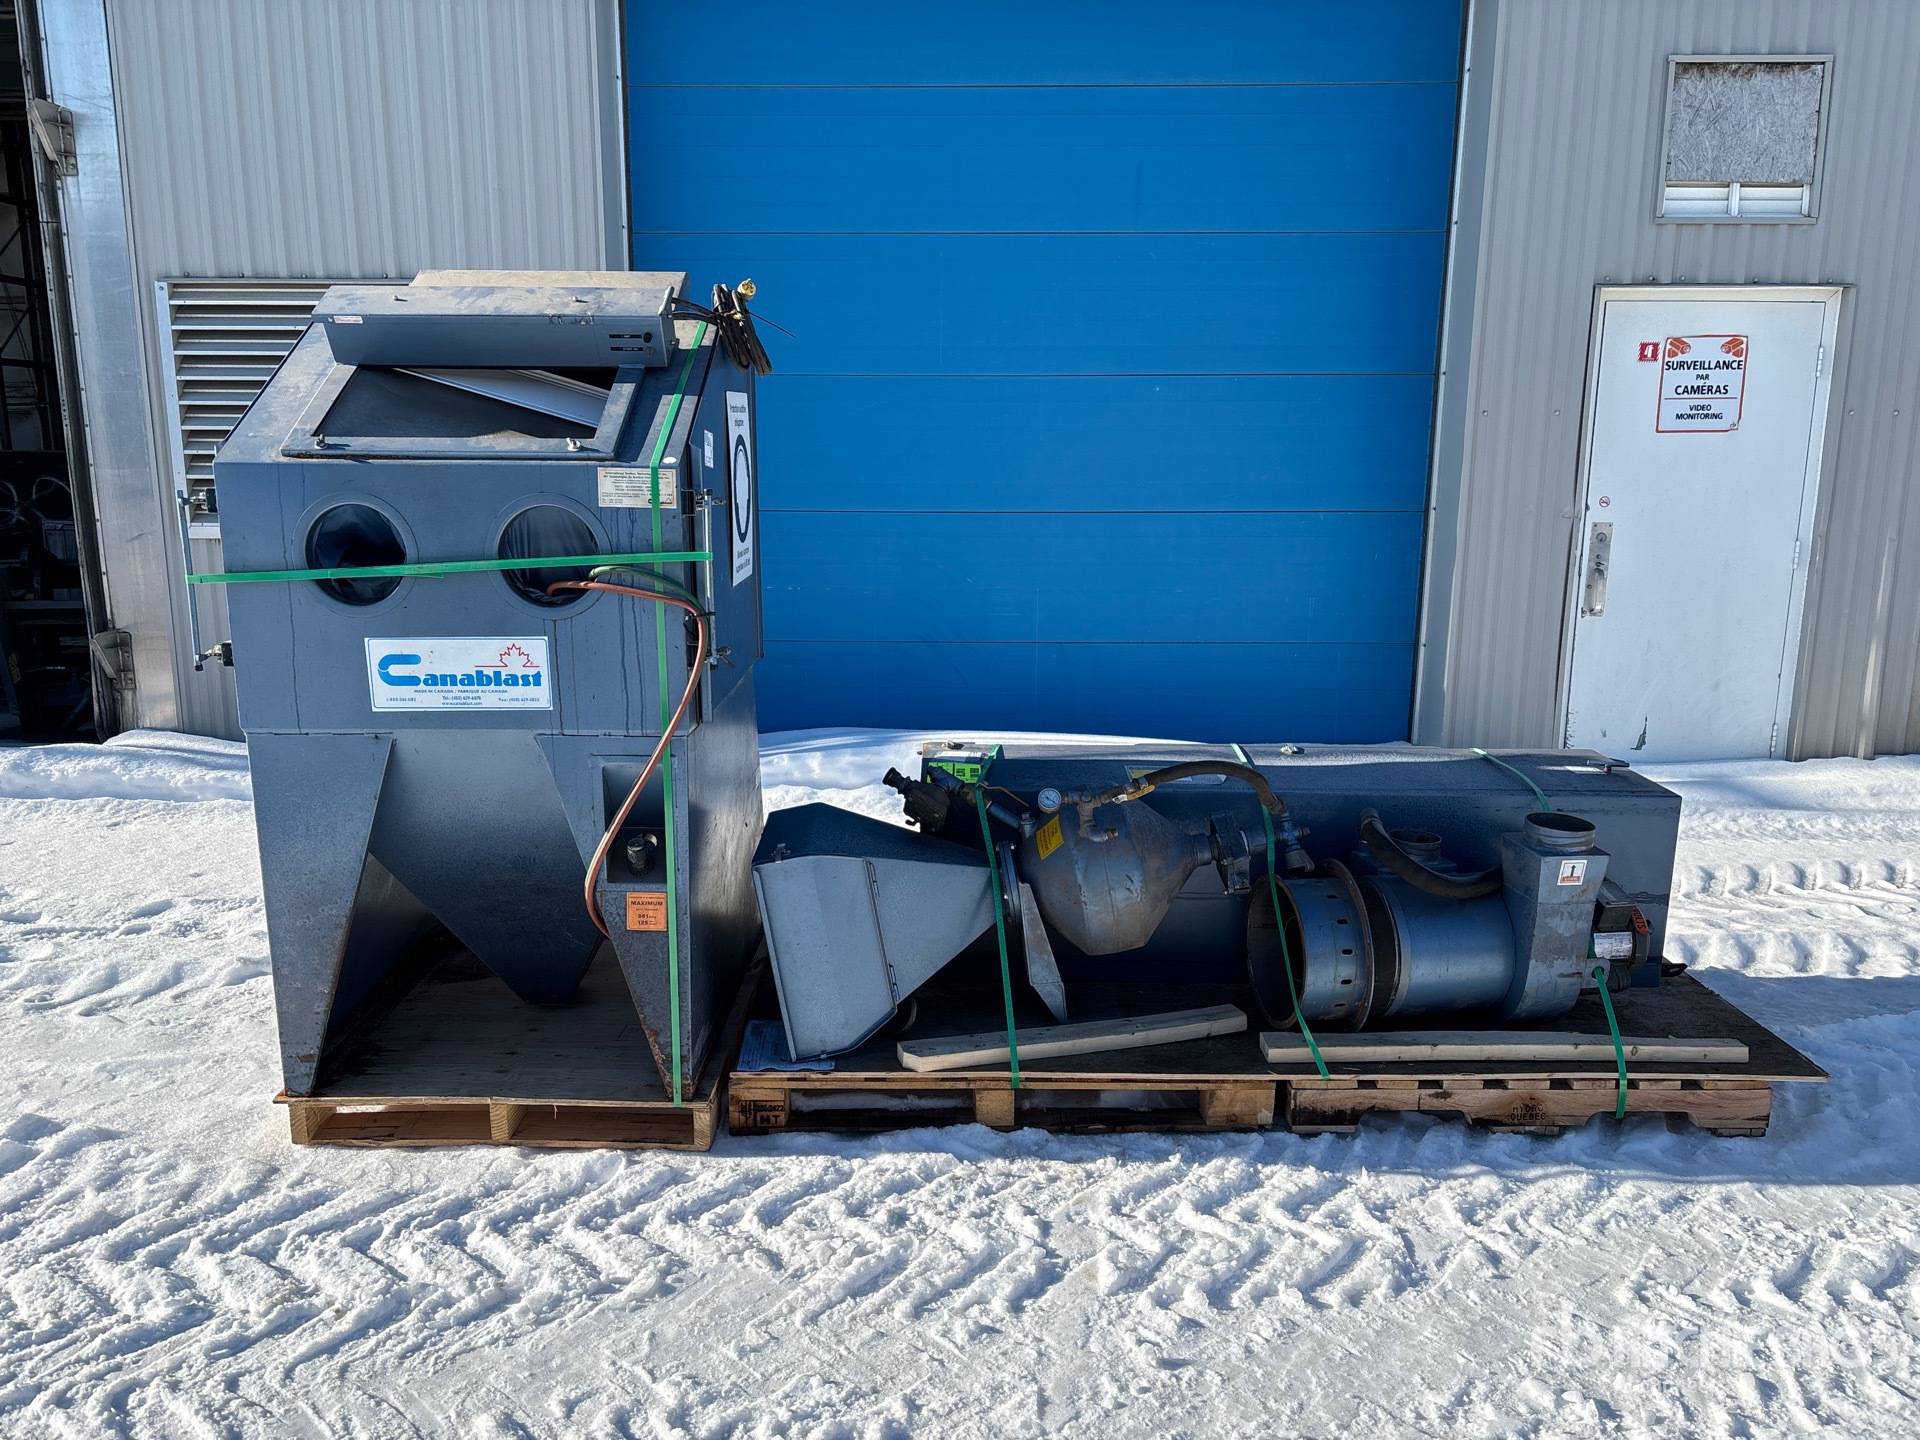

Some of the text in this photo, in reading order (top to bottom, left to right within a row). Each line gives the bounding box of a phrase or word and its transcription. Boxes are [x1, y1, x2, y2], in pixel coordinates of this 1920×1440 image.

[1665, 360, 1744, 371] SURVEILLANCE
[1695, 373, 1710, 381] PAR
[1674, 382, 1729, 396] CAMÉRAS
[1689, 404, 1712, 412] VIDEO
[1675, 412, 1724, 421] MONITORING
[378, 654, 542, 686] Canablast
[1512, 1104, 1544, 1113] HYDRO
[1510, 1112, 1547, 1121] QUEBEC
